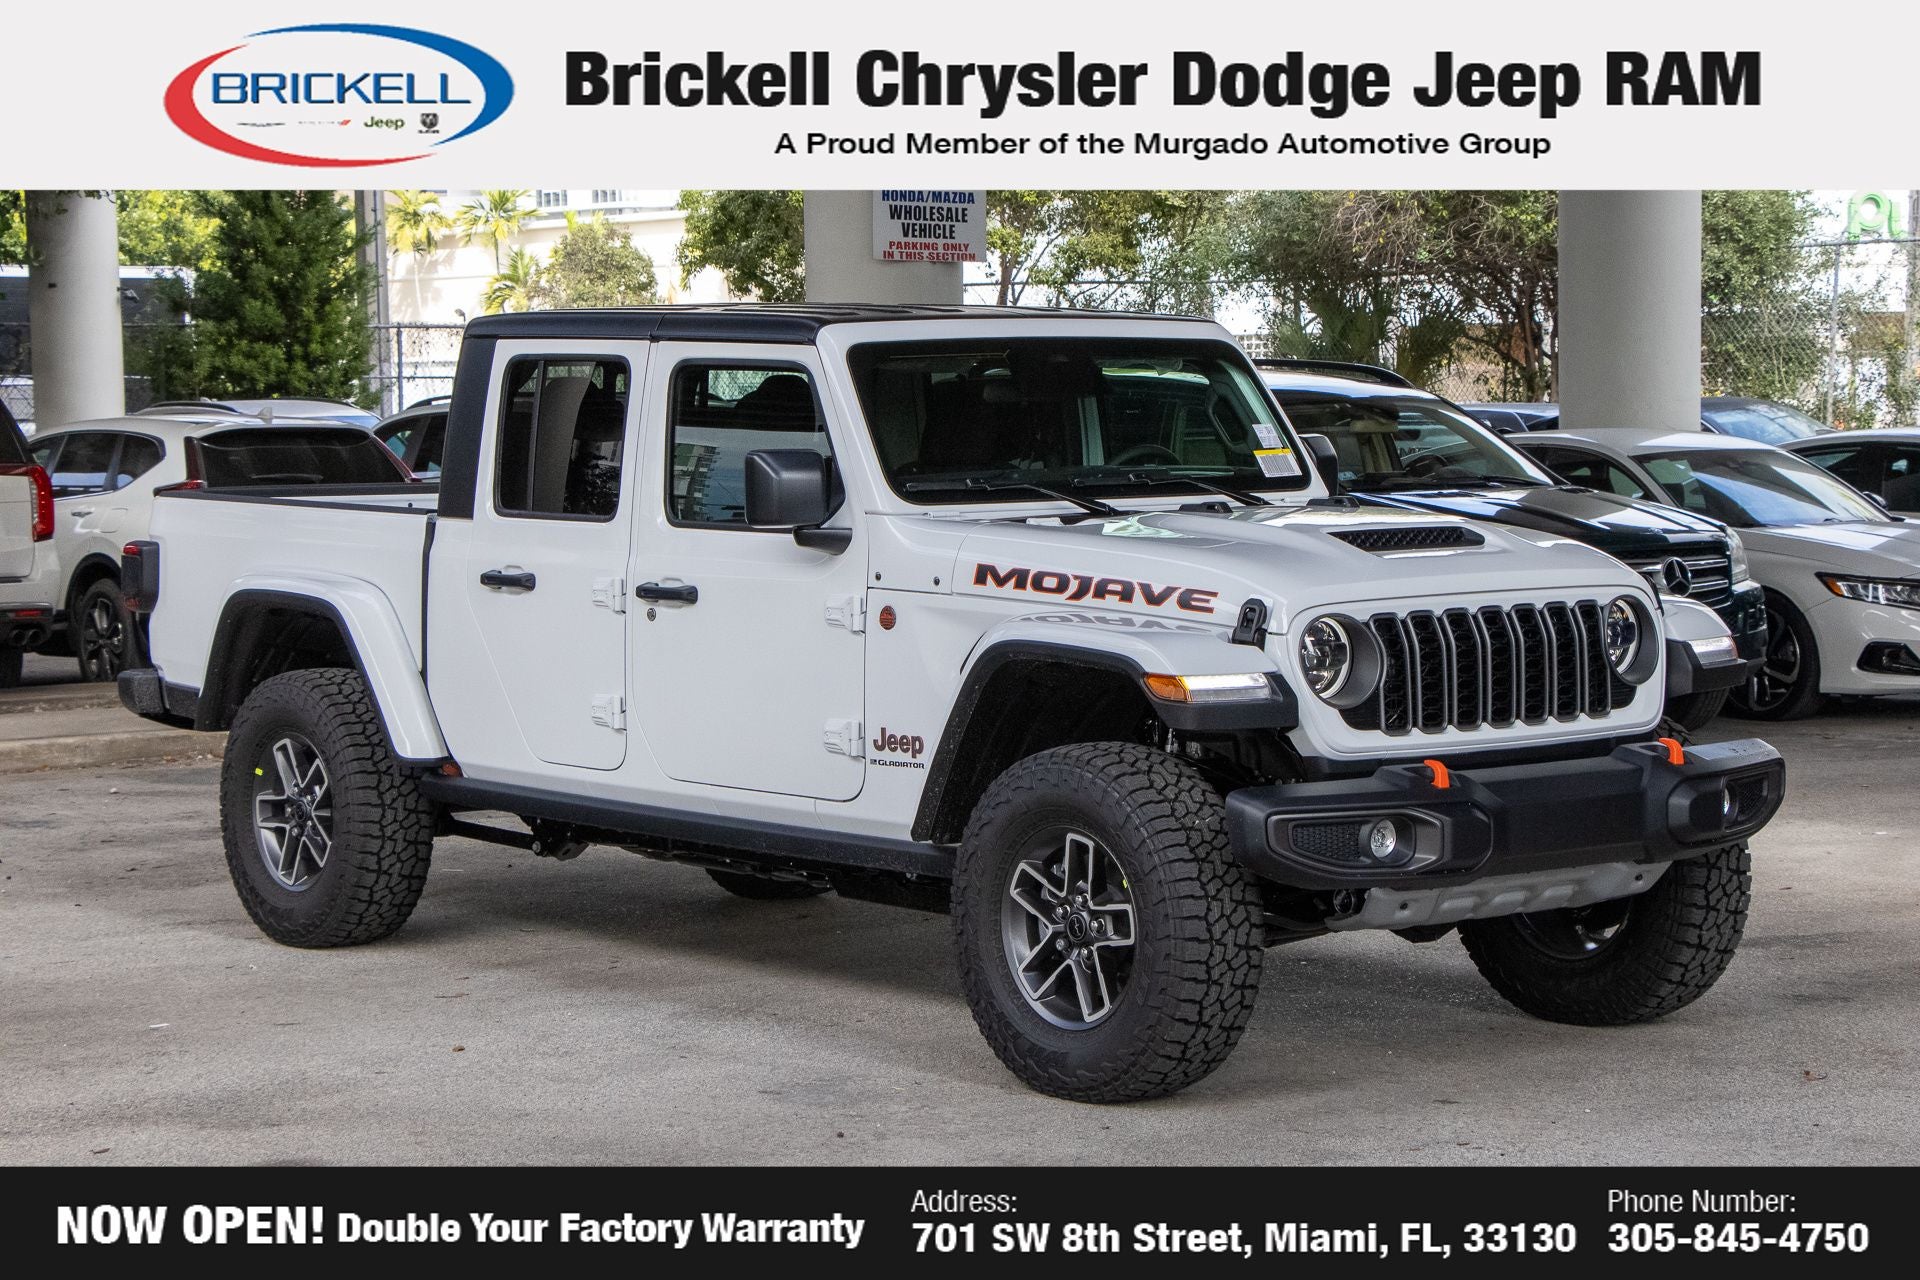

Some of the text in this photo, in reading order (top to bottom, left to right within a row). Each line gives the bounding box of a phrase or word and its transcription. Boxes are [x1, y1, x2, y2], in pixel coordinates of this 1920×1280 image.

[882, 190, 975, 204] HONDA/MAZDA
[889, 204, 968, 223] WHOLESALE
[902, 222, 955, 239] VEHICLE
[889, 241, 969, 252] PARKING ONLY
[883, 250, 976, 261] IN THIS SECTION
[973, 562, 1219, 614] MOJAVE
[873, 726, 924, 759] Jeep
[878, 759, 925, 769] GLADIATOR
